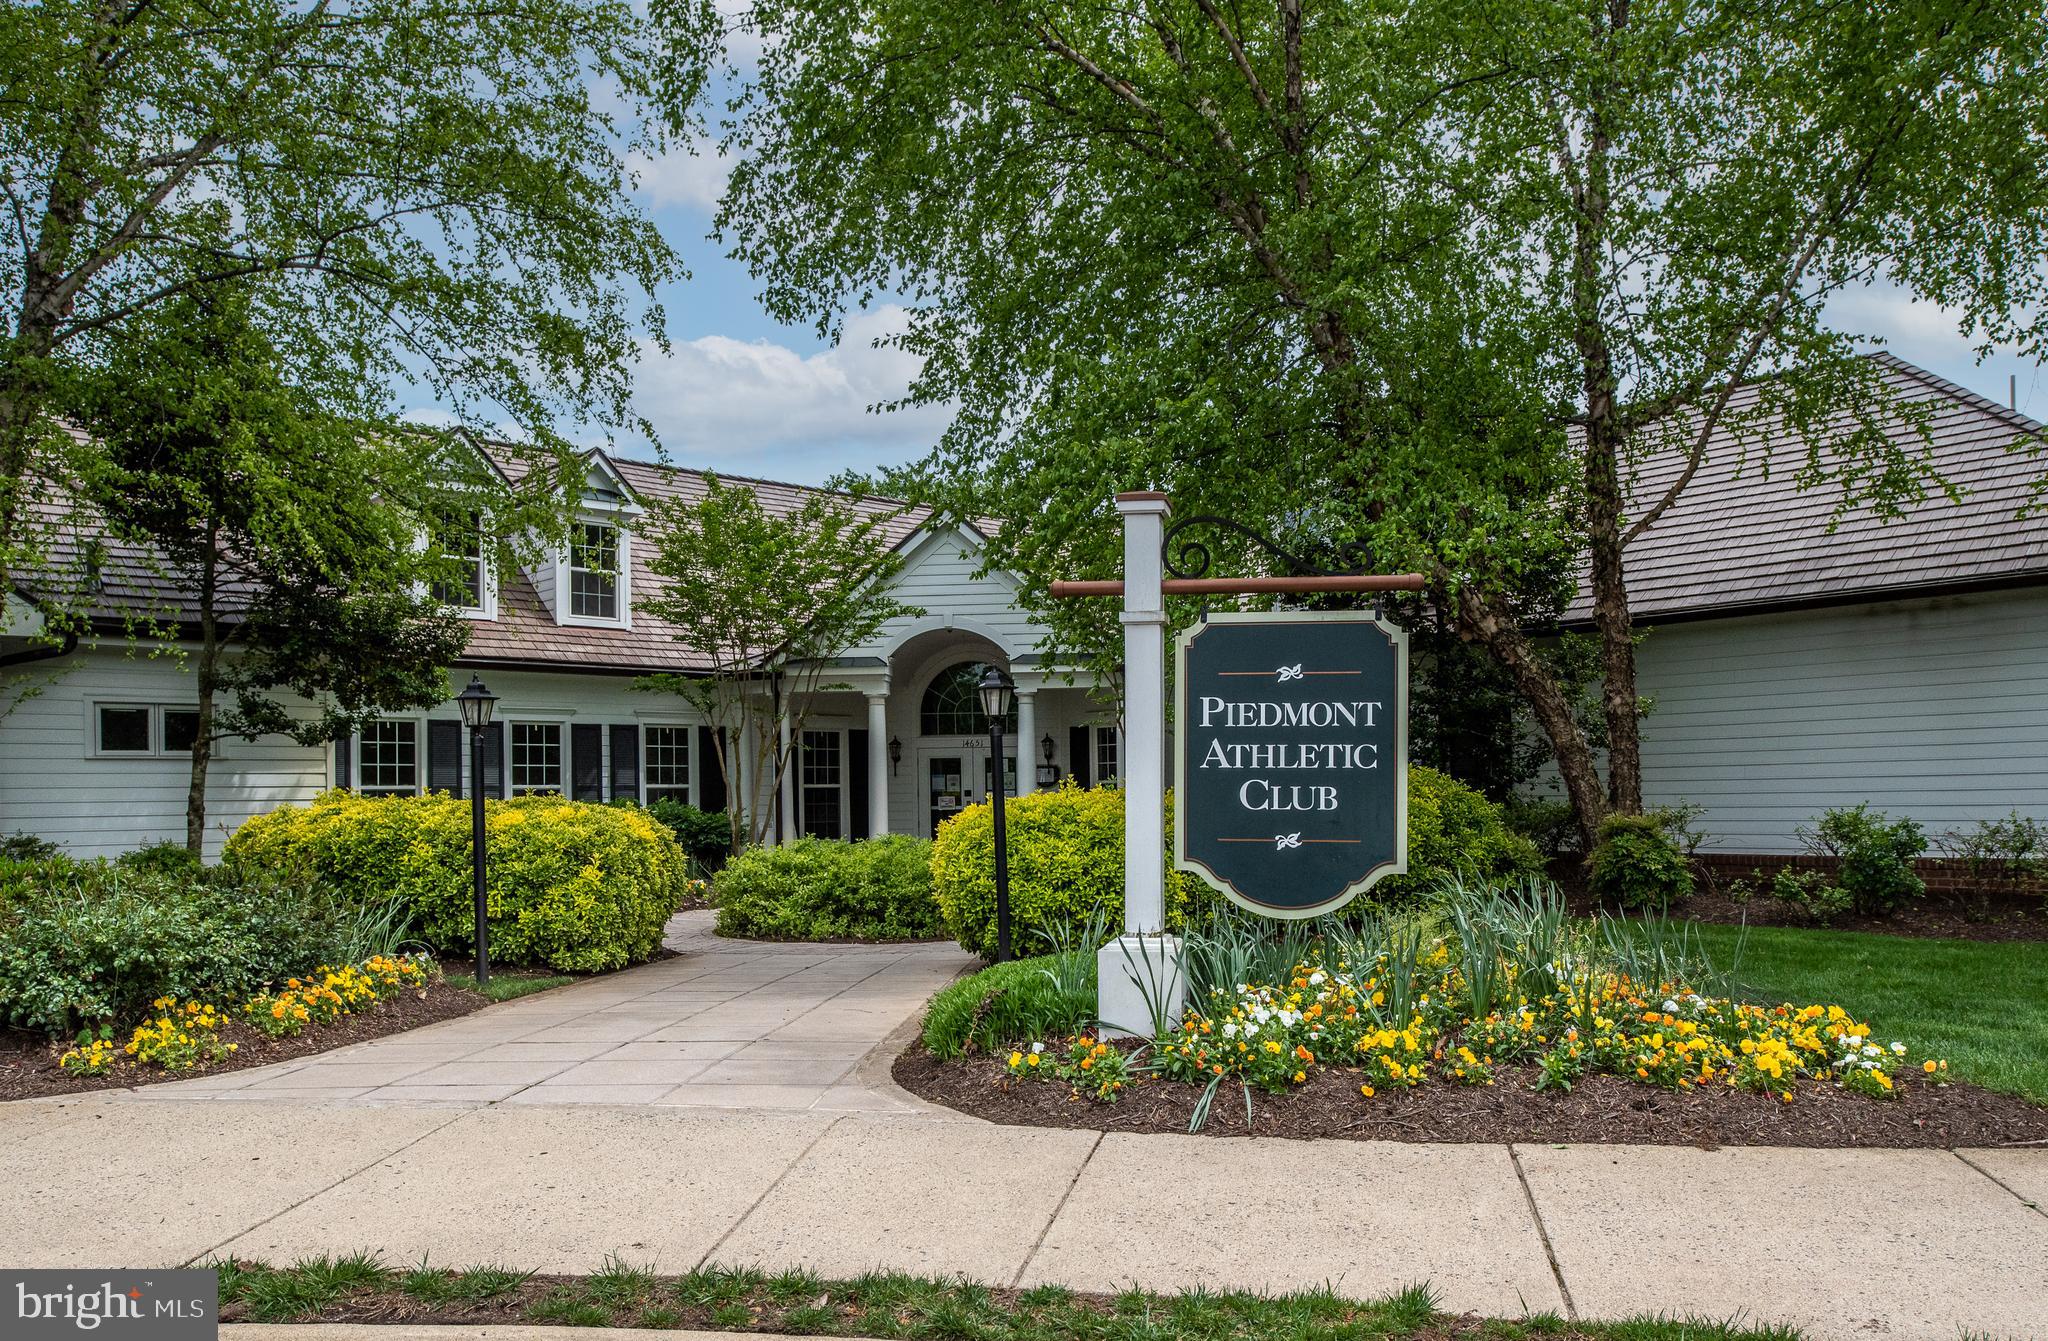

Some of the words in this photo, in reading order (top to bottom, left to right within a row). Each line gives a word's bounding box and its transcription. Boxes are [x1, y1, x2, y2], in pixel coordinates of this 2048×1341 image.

[1199, 696, 1383, 727] PIEDMONT
[962, 739, 983, 748] 14651
[1199, 737, 1378, 769] ATHLETIC
[1239, 779, 1338, 811] CLUB
